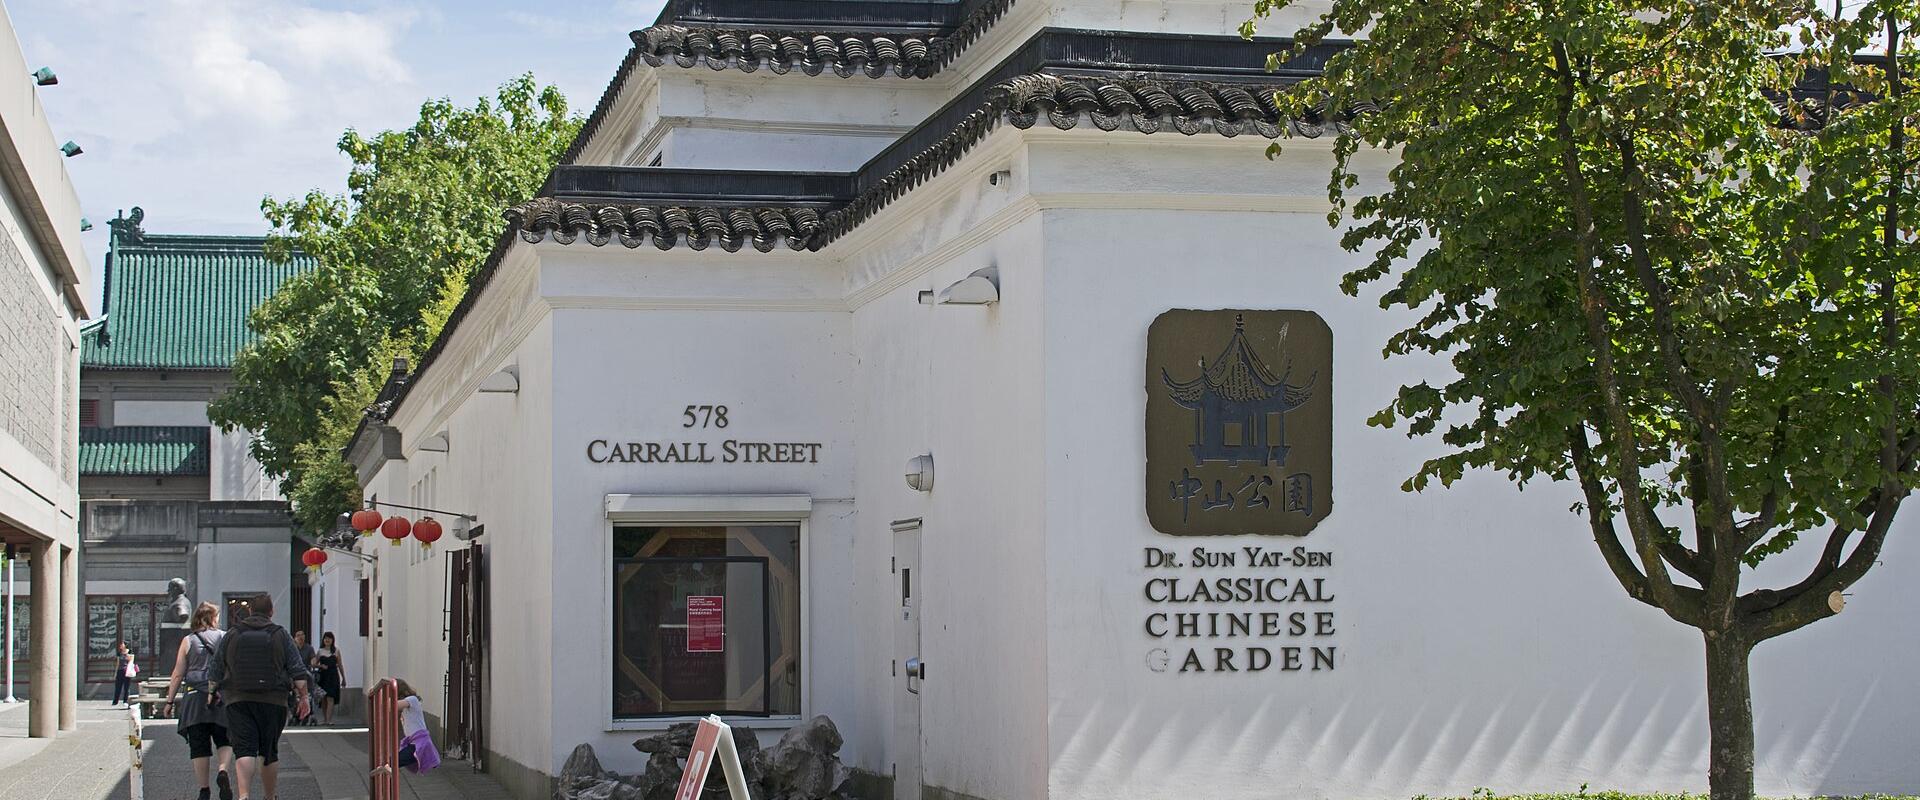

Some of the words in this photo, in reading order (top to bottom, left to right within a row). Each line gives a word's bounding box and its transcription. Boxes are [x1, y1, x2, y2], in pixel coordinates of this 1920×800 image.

[683, 405, 729, 429] 578
[587, 439, 715, 464] CARRALL
[722, 439, 822, 464] STREET
[1169, 467, 1313, 525] 中山公園
[1144, 547, 1184, 568] DR.
[1192, 546, 1236, 568] SUN
[1243, 546, 1333, 568] YAT-SEN
[1144, 577, 1335, 603] CLASSICAL
[1145, 612, 1336, 638] CHINESE
